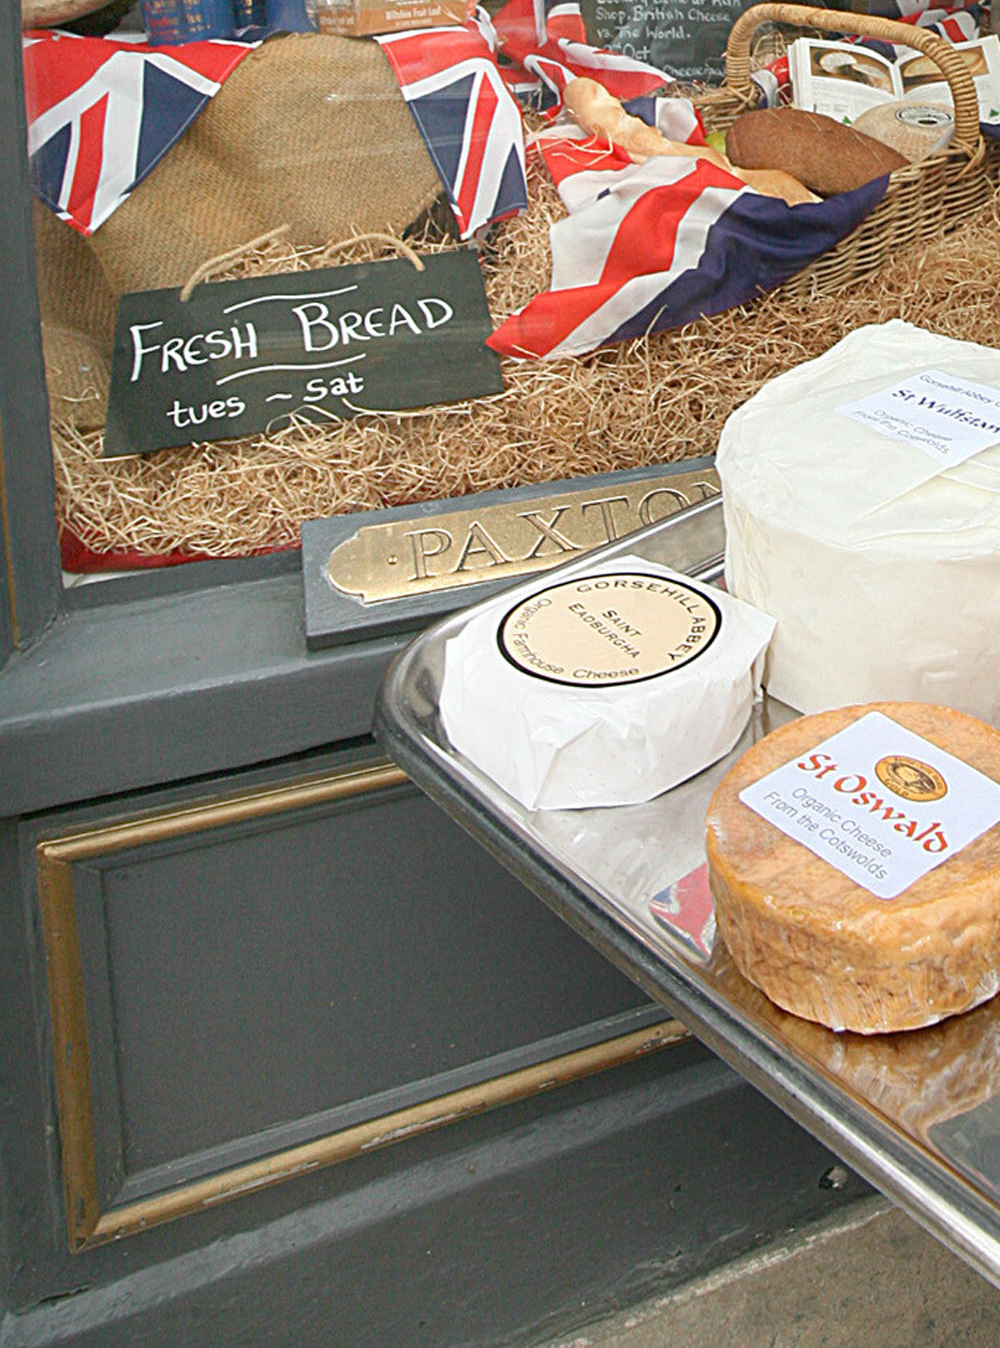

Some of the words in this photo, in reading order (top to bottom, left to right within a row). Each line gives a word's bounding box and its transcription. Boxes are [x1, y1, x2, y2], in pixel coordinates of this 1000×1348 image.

[615, 26, 639, 39] The
[646, 25, 691, 40] World.
[633, 5, 684, 22] British
[688, 7, 730, 22] Cheese
[130, 321, 258, 381] FRESH
[291, 298, 454, 352] BREAD
[165, 395, 246, 428] tues
[891, 388, 916, 402] St
[567, 603, 641, 659] EADBURGHA
[576, 579, 699, 614] GORSEHILL
[667, 616, 707, 661] ABBEY
[601, 609, 642, 638] SAINT
[512, 632, 565, 675] Farmhouse
[572, 667, 640, 679] Cheese
[791, 787, 842, 825] Organic
[840, 819, 893, 858] Cheese
[796, 753, 838, 780] St
[833, 774, 949, 854] Oswald
[763, 791, 798, 819] From
[796, 812, 820, 833] the
[818, 829, 889, 880] Cotswolds
